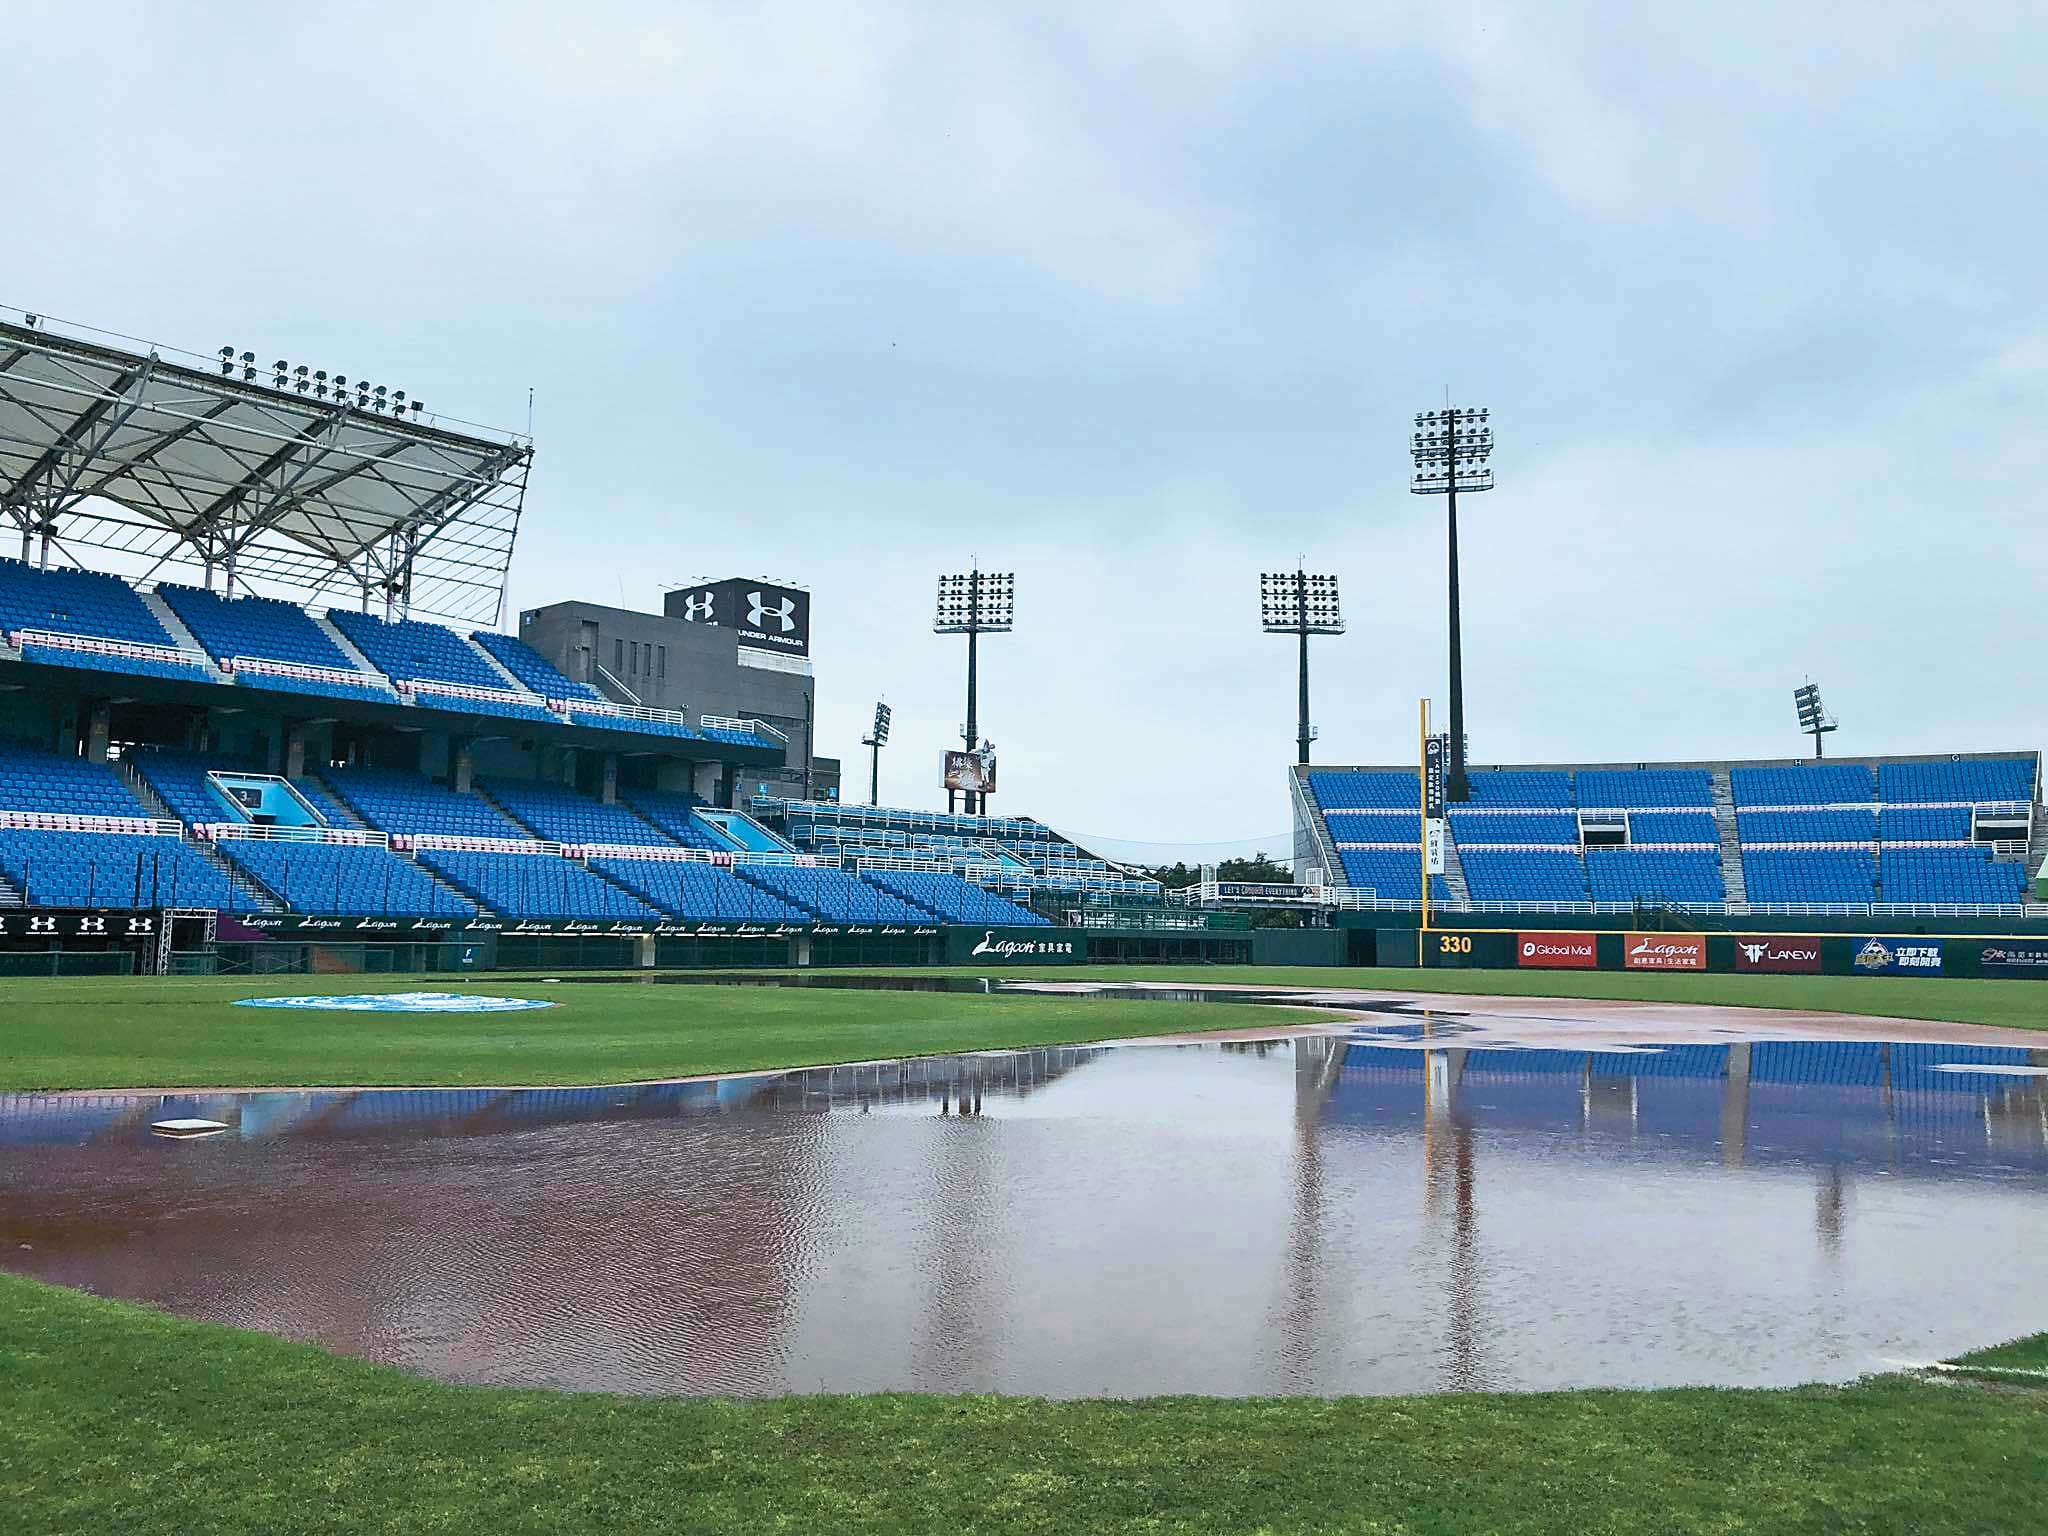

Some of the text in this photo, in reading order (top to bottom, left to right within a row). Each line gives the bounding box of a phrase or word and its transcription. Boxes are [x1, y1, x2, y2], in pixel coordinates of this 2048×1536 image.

[738, 629, 804, 647] UNDER ARMOUR
[240, 791, 247, 801] 3
[972, 931, 1036, 958] Lagoon
[1440, 936, 1472, 953] 330
[1537, 944, 1592, 956] Global Mall
[1630, 937, 1699, 957] Lagoon
[1768, 949, 1817, 961] LANEW
[1895, 947, 1939, 957] 立即下載
